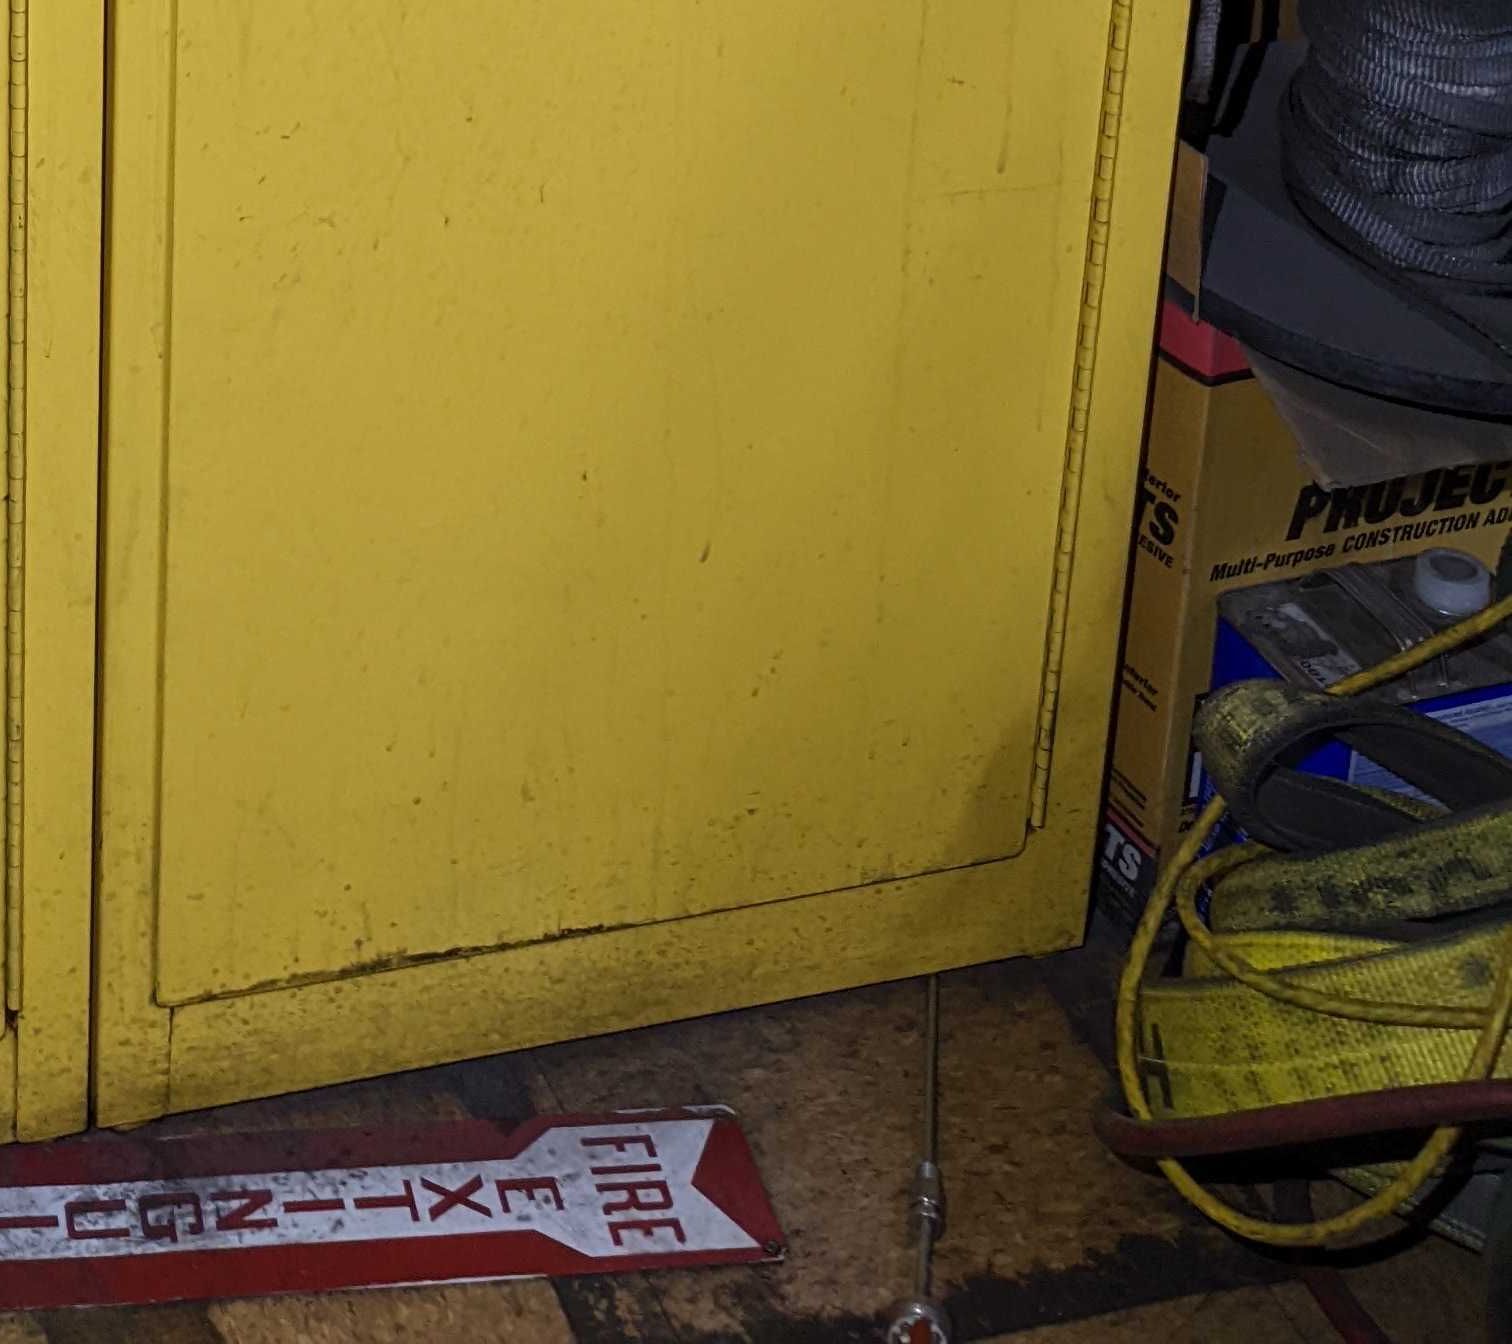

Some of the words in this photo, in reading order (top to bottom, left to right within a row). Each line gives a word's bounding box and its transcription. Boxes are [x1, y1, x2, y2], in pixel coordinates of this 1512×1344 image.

[1210, 543, 1335, 582] Multi-Purpose
[1342, 512, 1480, 553] CONSTRUCTION
[581, 1134, 686, 1246] FIRE
